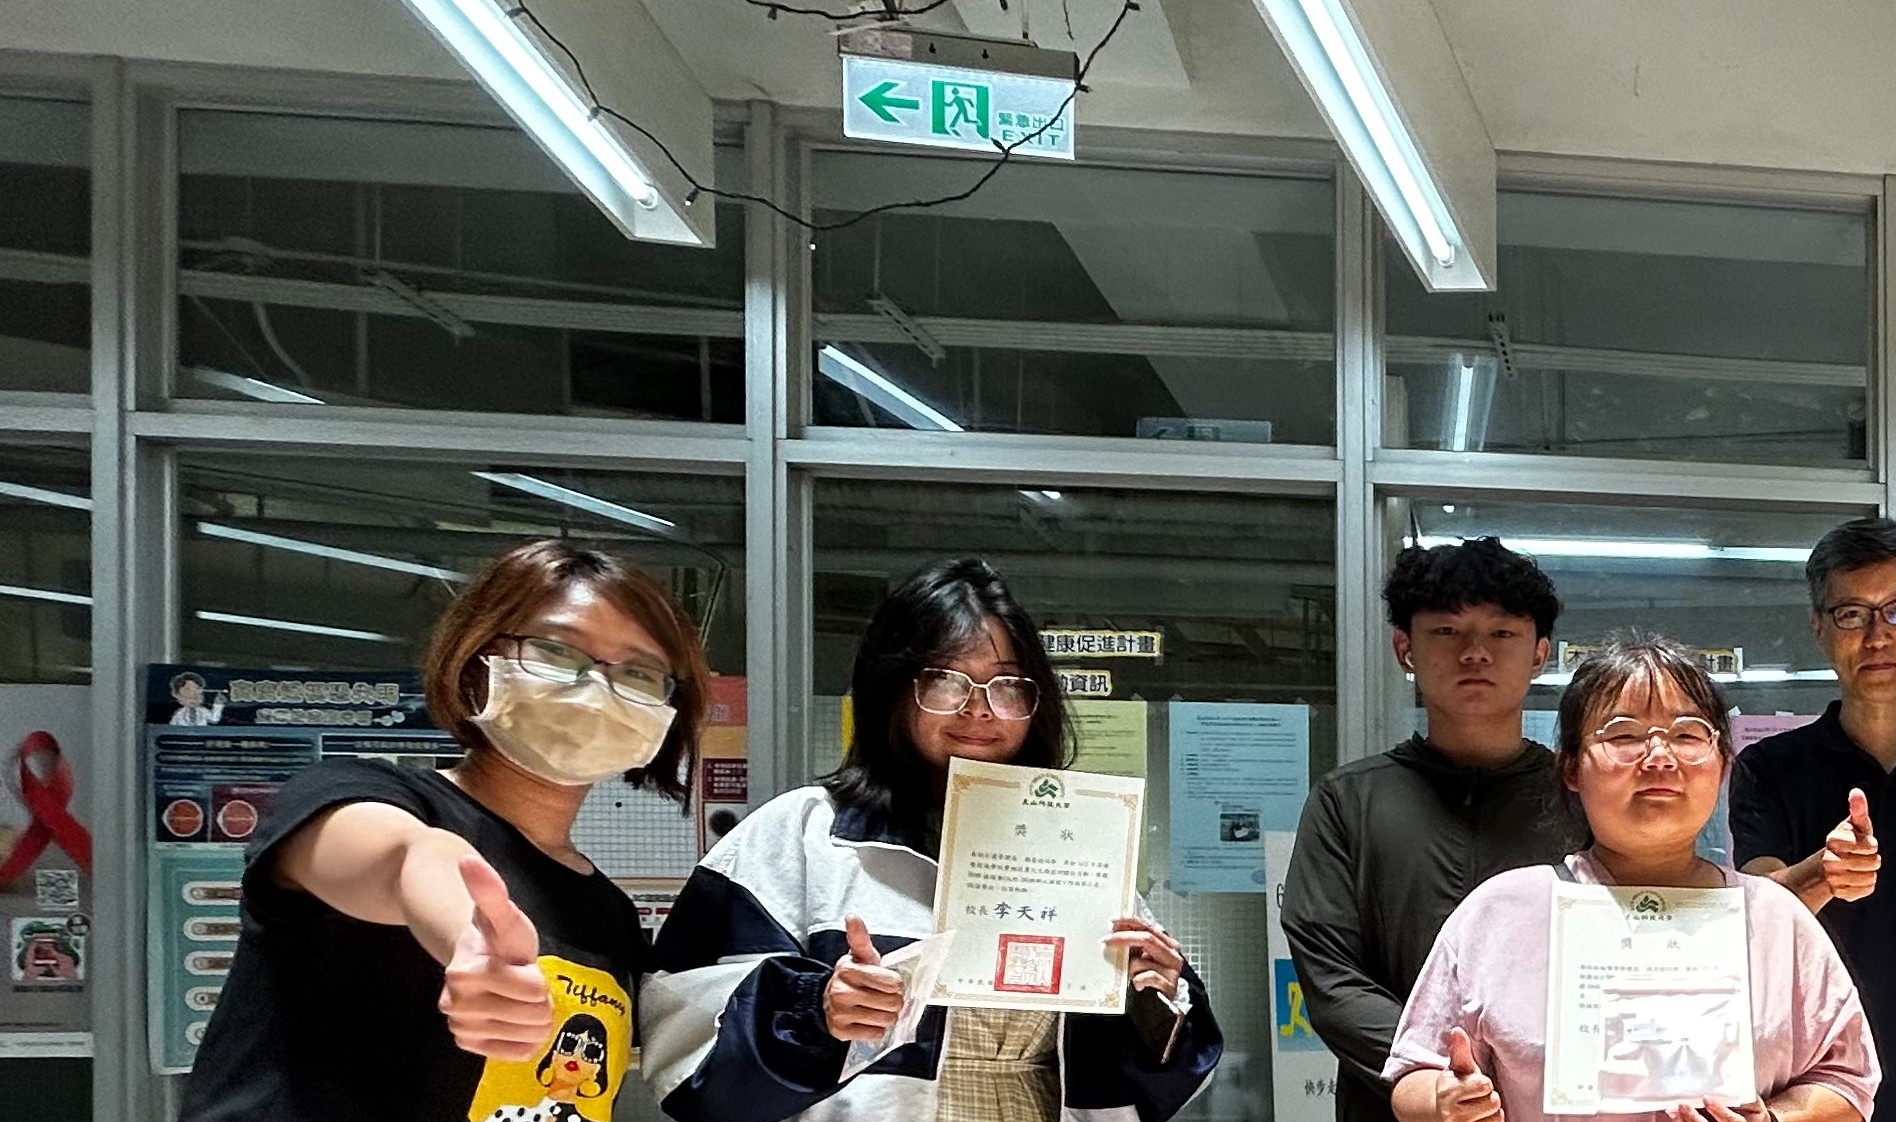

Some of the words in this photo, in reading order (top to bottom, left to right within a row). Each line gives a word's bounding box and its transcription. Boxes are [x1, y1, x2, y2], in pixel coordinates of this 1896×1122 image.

[998, 112, 1065, 131] 緊急出口
[1002, 129, 1061, 146] EXIT
[993, 901, 1058, 922] 李天祥
